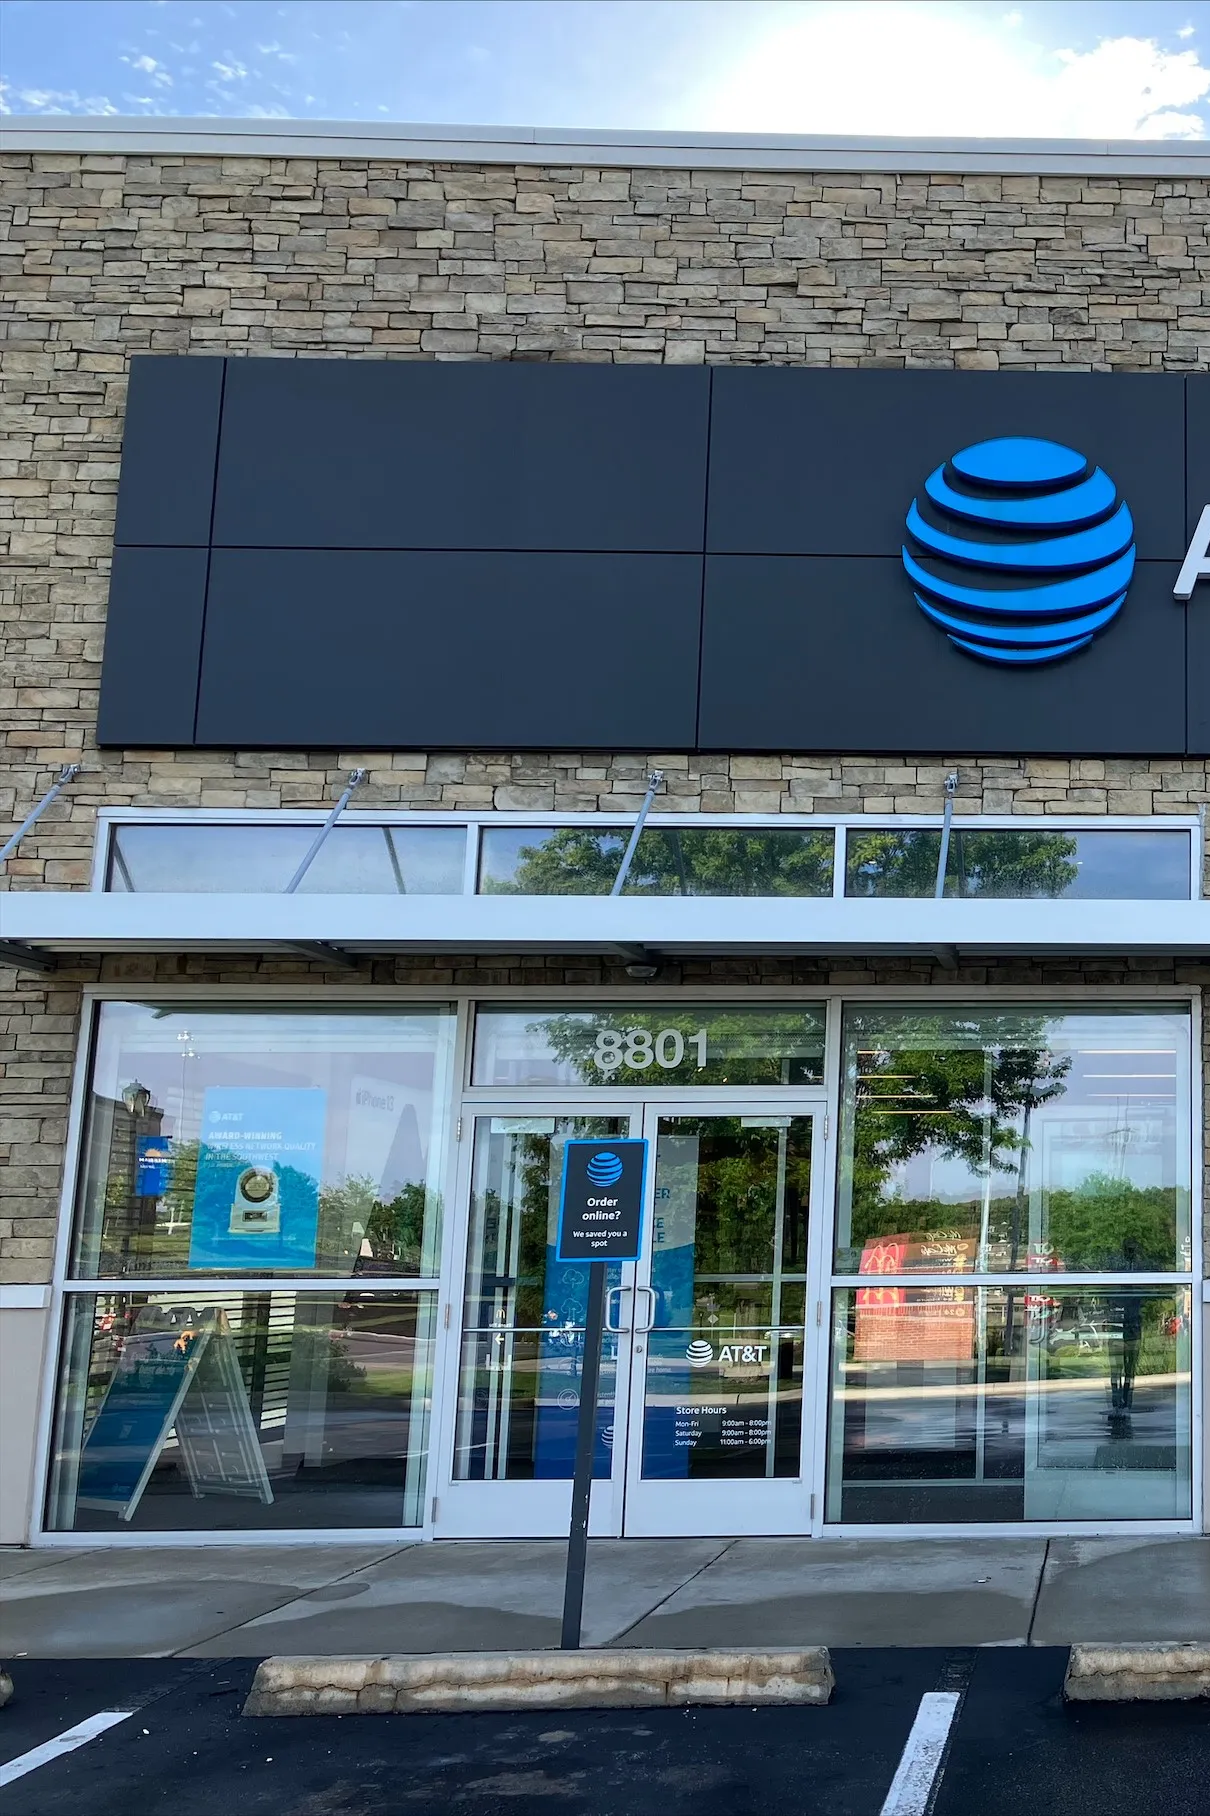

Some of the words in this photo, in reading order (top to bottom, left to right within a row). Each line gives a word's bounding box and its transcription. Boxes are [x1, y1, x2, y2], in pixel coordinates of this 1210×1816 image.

[594, 1028, 707, 1070] 8801
[221, 1112, 244, 1122] AT&T
[208, 1131, 282, 1140] AWARD-WINNING
[245, 1142, 282, 1151] NETWORK
[284, 1142, 317, 1151] QUALITY
[205, 1153, 214, 1161] IN
[216, 1153, 230, 1161] THE
[232, 1152, 279, 1161] SOUTHWEST
[587, 1197, 618, 1207] Order
[582, 1211, 621, 1221] online?
[586, 1230, 606, 1238] saved
[608, 1231, 621, 1241] you
[591, 1240, 608, 1248] spot
[718, 1345, 767, 1362] AT&T
[676, 1406, 700, 1414] Store
[702, 1406, 727, 1414] Hours
[749, 1420, 772, 1428] 8:00pm
[675, 1430, 702, 1438] Saturday
[749, 1430, 772, 1438] 8:00pm
[675, 1439, 697, 1447] Sunday
[748, 1439, 771, 1447] 6:00pm
